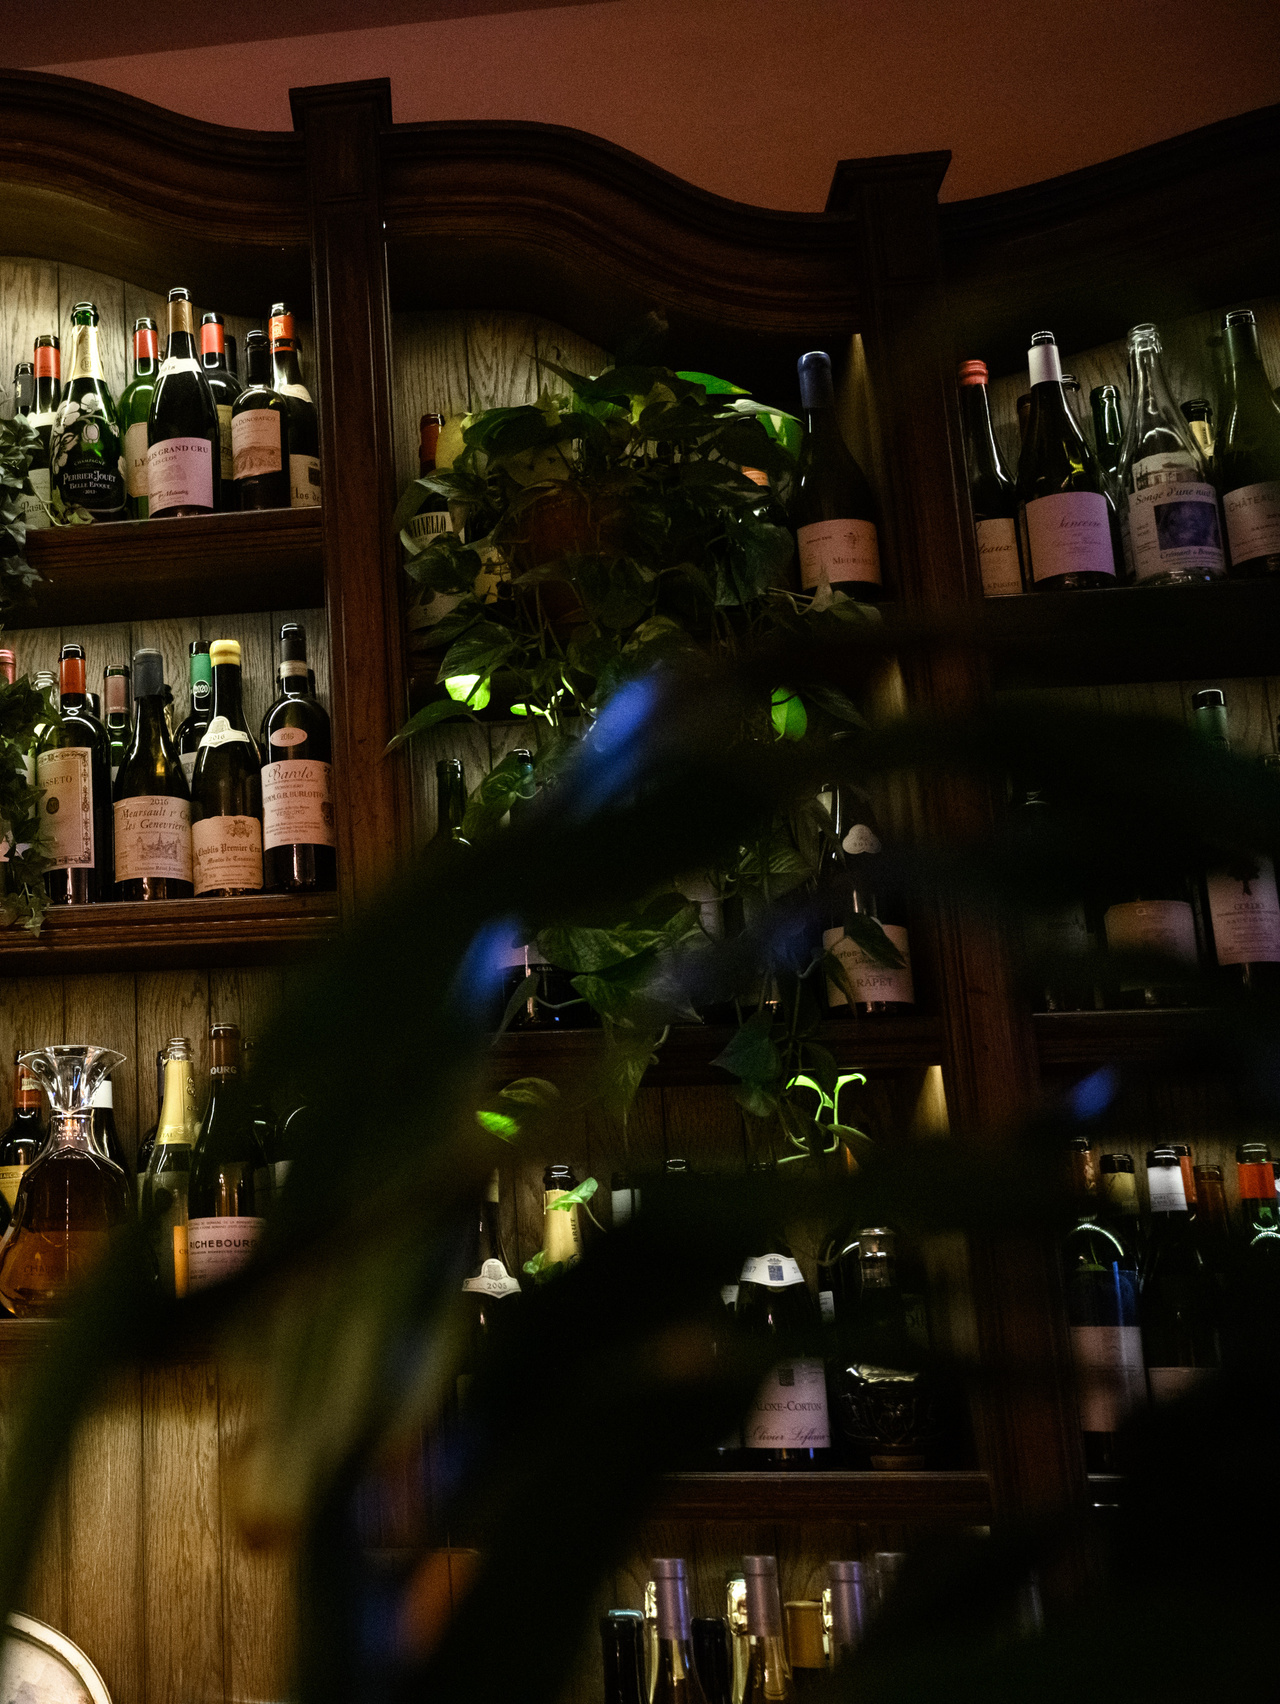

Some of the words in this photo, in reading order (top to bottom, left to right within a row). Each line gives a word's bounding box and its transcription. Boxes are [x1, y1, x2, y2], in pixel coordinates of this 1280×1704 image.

[157, 444, 189, 457] GRAND
[190, 444, 209, 453] CRU
[74, 459, 106, 467] CHAMPAGNE
[1135, 494, 1163, 506] Songe
[1167, 487, 1192, 502] d'une
[268, 765, 314, 781] Barolo
[220, 843, 248, 853] Premier
[570, 1218, 578, 1242] BRUT
